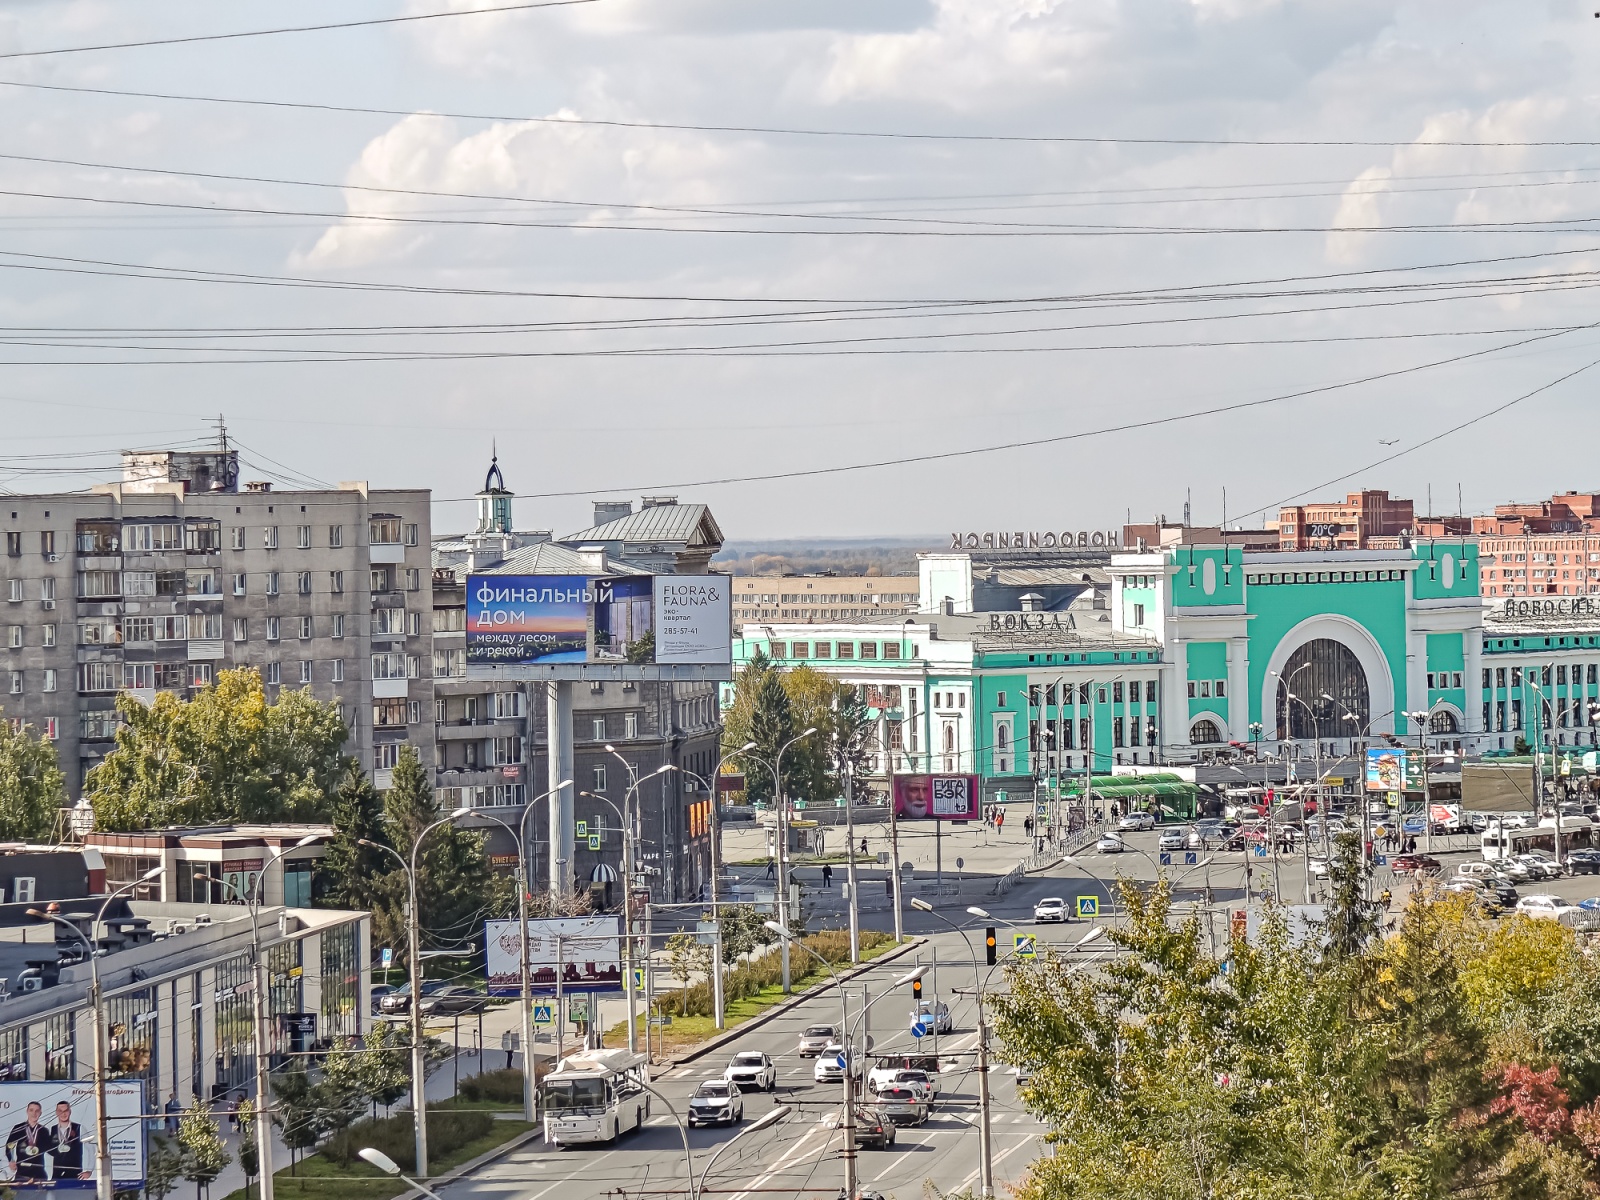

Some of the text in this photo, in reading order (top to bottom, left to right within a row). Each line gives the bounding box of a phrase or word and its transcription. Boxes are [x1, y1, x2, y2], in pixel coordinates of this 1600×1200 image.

[476, 581, 613, 607] финальный
[663, 585, 707, 595] FLORA
[663, 596, 708, 606] FAUNA
[476, 609, 525, 628] дом
[990, 613, 1077, 631] ВОКЗАЛ
[663, 627, 698, 635] 285-57-41
[476, 634, 556, 645] между лесом
[476, 644, 524, 660] и рекой
[934, 780, 964, 789] ГИГА
[934, 789, 964, 798] БЭК
